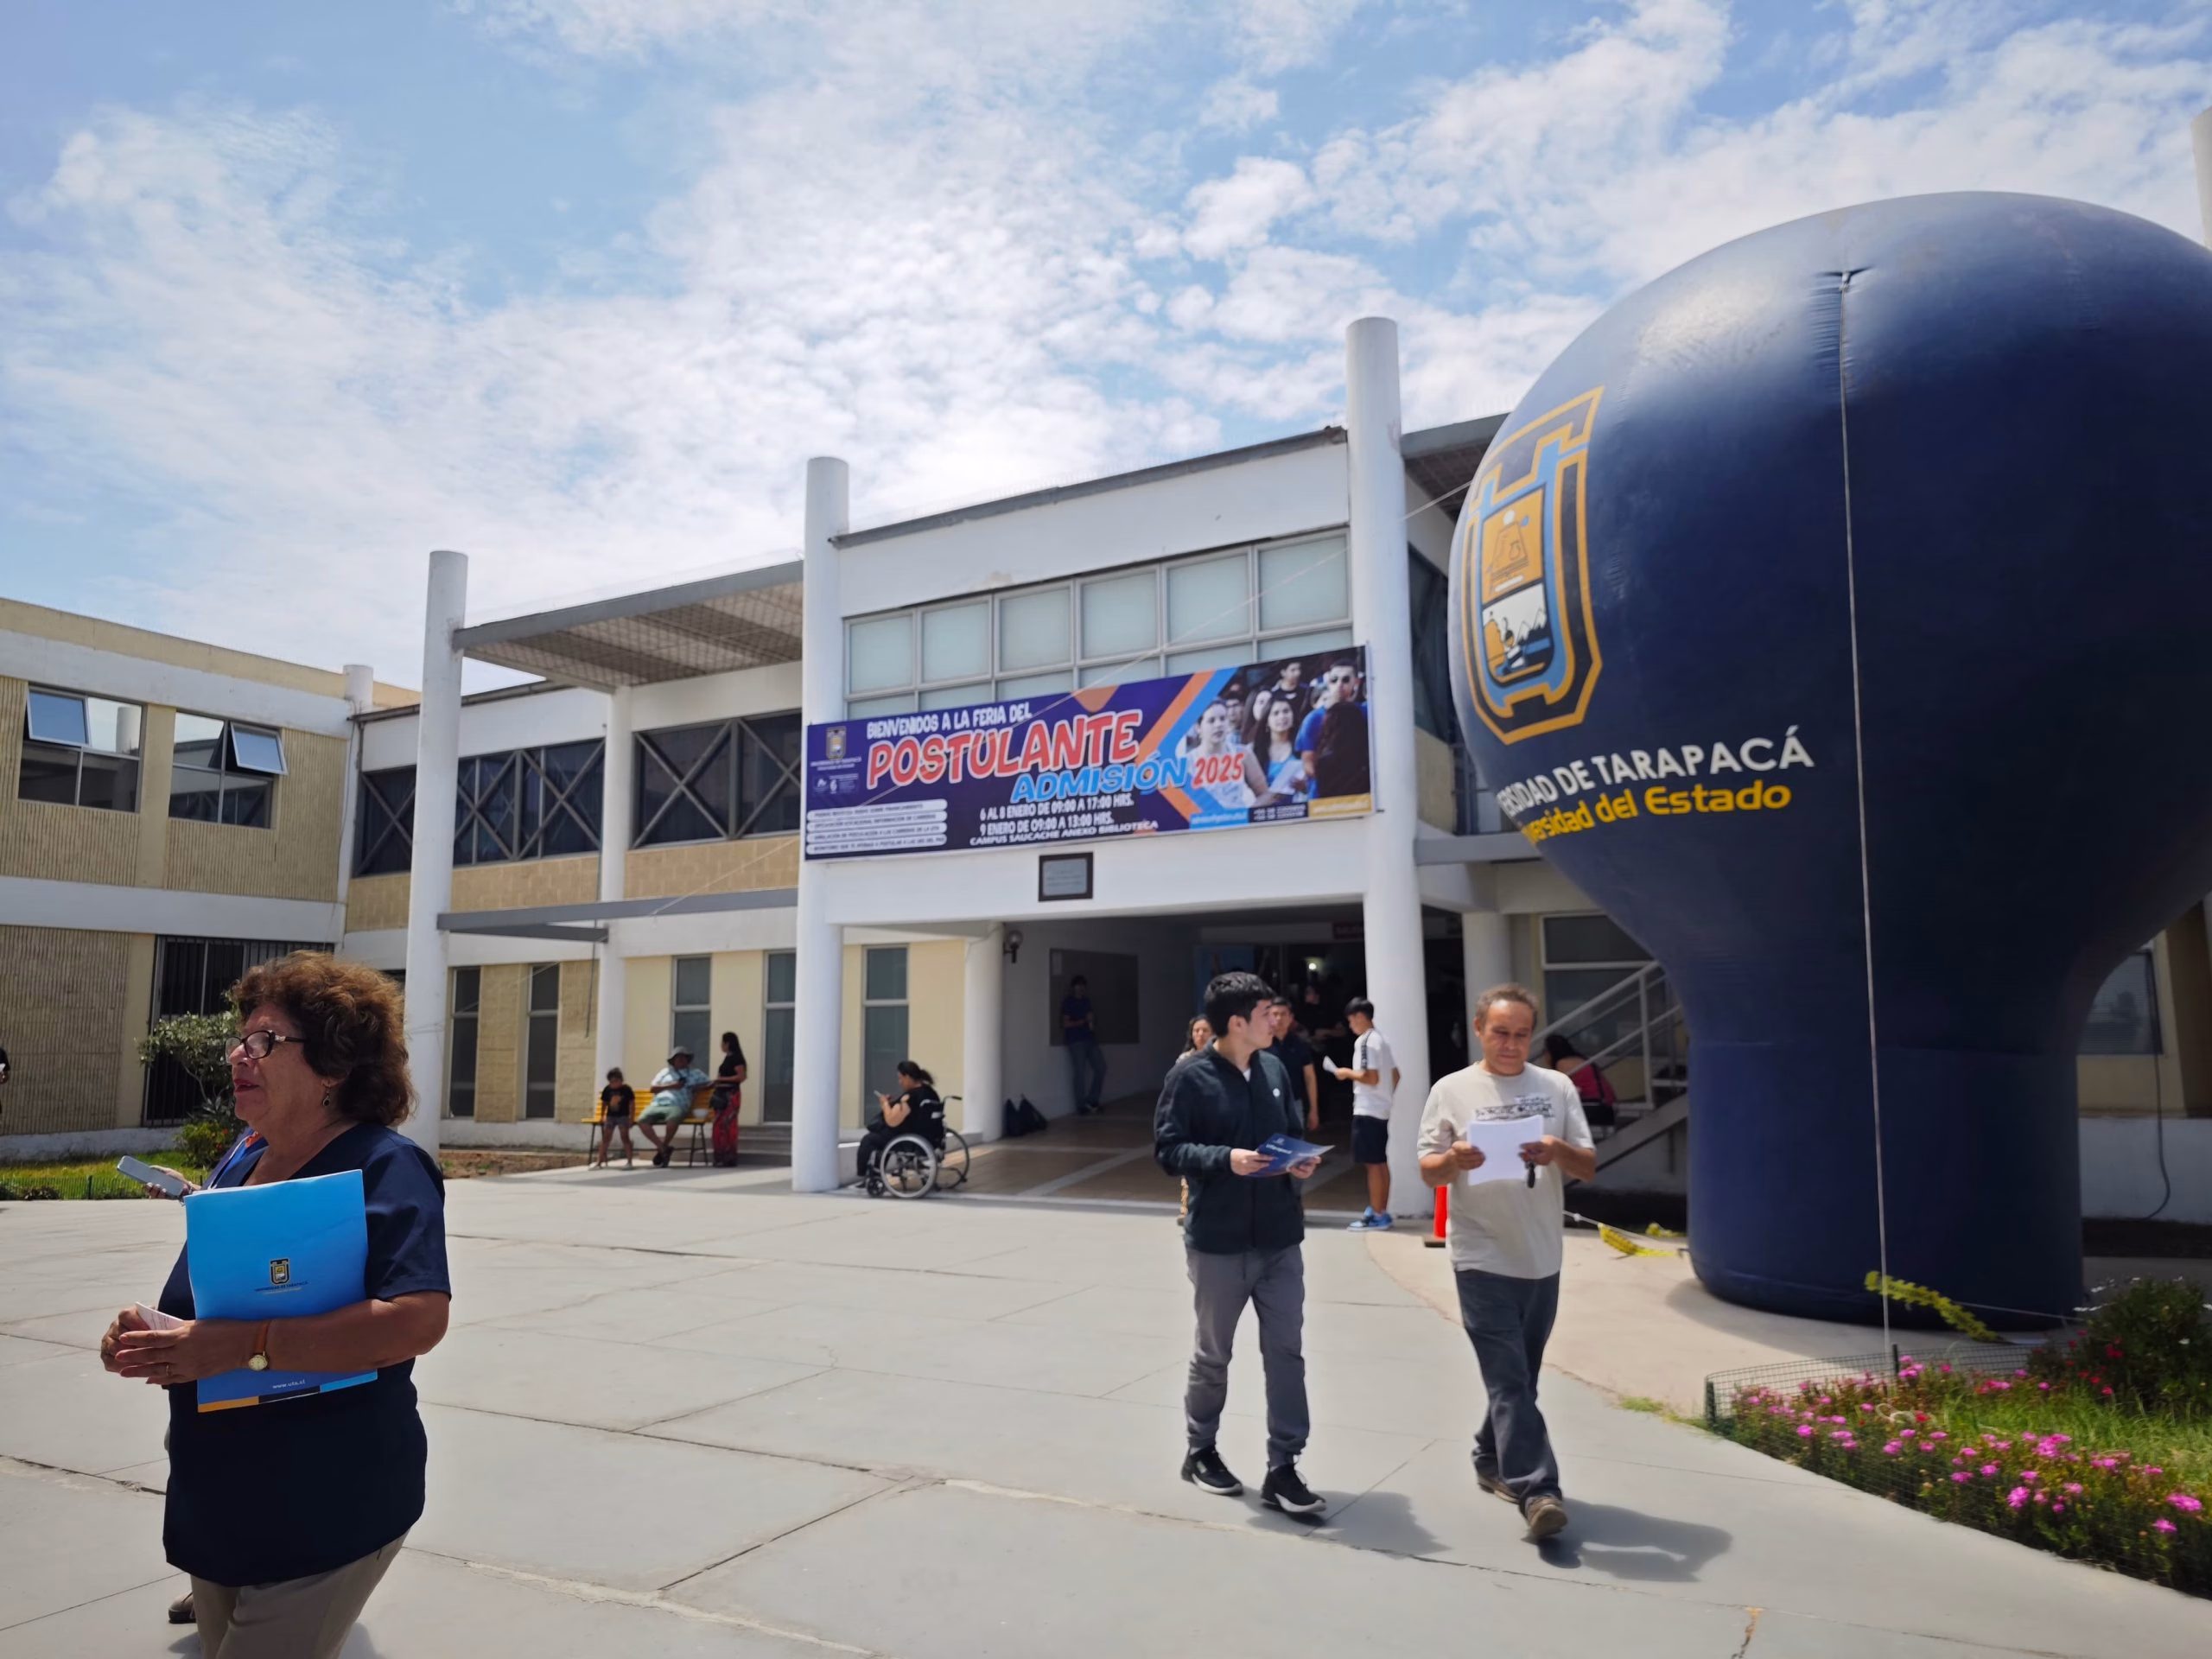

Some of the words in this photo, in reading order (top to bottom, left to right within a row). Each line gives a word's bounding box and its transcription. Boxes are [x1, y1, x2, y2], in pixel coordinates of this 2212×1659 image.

[867, 713, 939, 740] BIENVENIDOS
[942, 712, 951, 731] A
[954, 709, 970, 729] LA
[973, 705, 1007, 728] FERIA
[1009, 702, 1033, 722] DEL
[867, 709, 1142, 790] POSTULANTE
[1553, 760, 1596, 796] DE
[1591, 724, 1815, 785] TARAPACÁ
[1010, 752, 1187, 804] ADMISIÓN
[1192, 753, 1245, 788] 2025
[980, 808, 986, 821] 6
[988, 806, 999, 820] AL
[1000, 805, 1006, 819] 8
[1007, 804, 1036, 819] ENERO
[1038, 802, 1050, 816] DE
[1052, 799, 1077, 814] 09:00
[1077, 798, 1085, 811] A
[1087, 795, 1112, 810] 17:00
[1113, 793, 1135, 807] HRS.
[1595, 789, 1638, 823] del
[1644, 780, 1792, 815] Estado
[969, 835, 1007, 846] CAMPUS
[1009, 831, 1059, 842] SAUCACHE
[1061, 827, 1097, 838] ANEXO
[1098, 820, 1159, 834] BIBLIOTECA
[980, 823, 986, 836] 9
[988, 820, 1015, 836] ENERO
[1017, 819, 1029, 833] DE
[1031, 817, 1058, 832] 09:00
[1058, 816, 1066, 829] A
[1068, 813, 1092, 828] 13:00
[1094, 810, 1115, 824] HRS.
